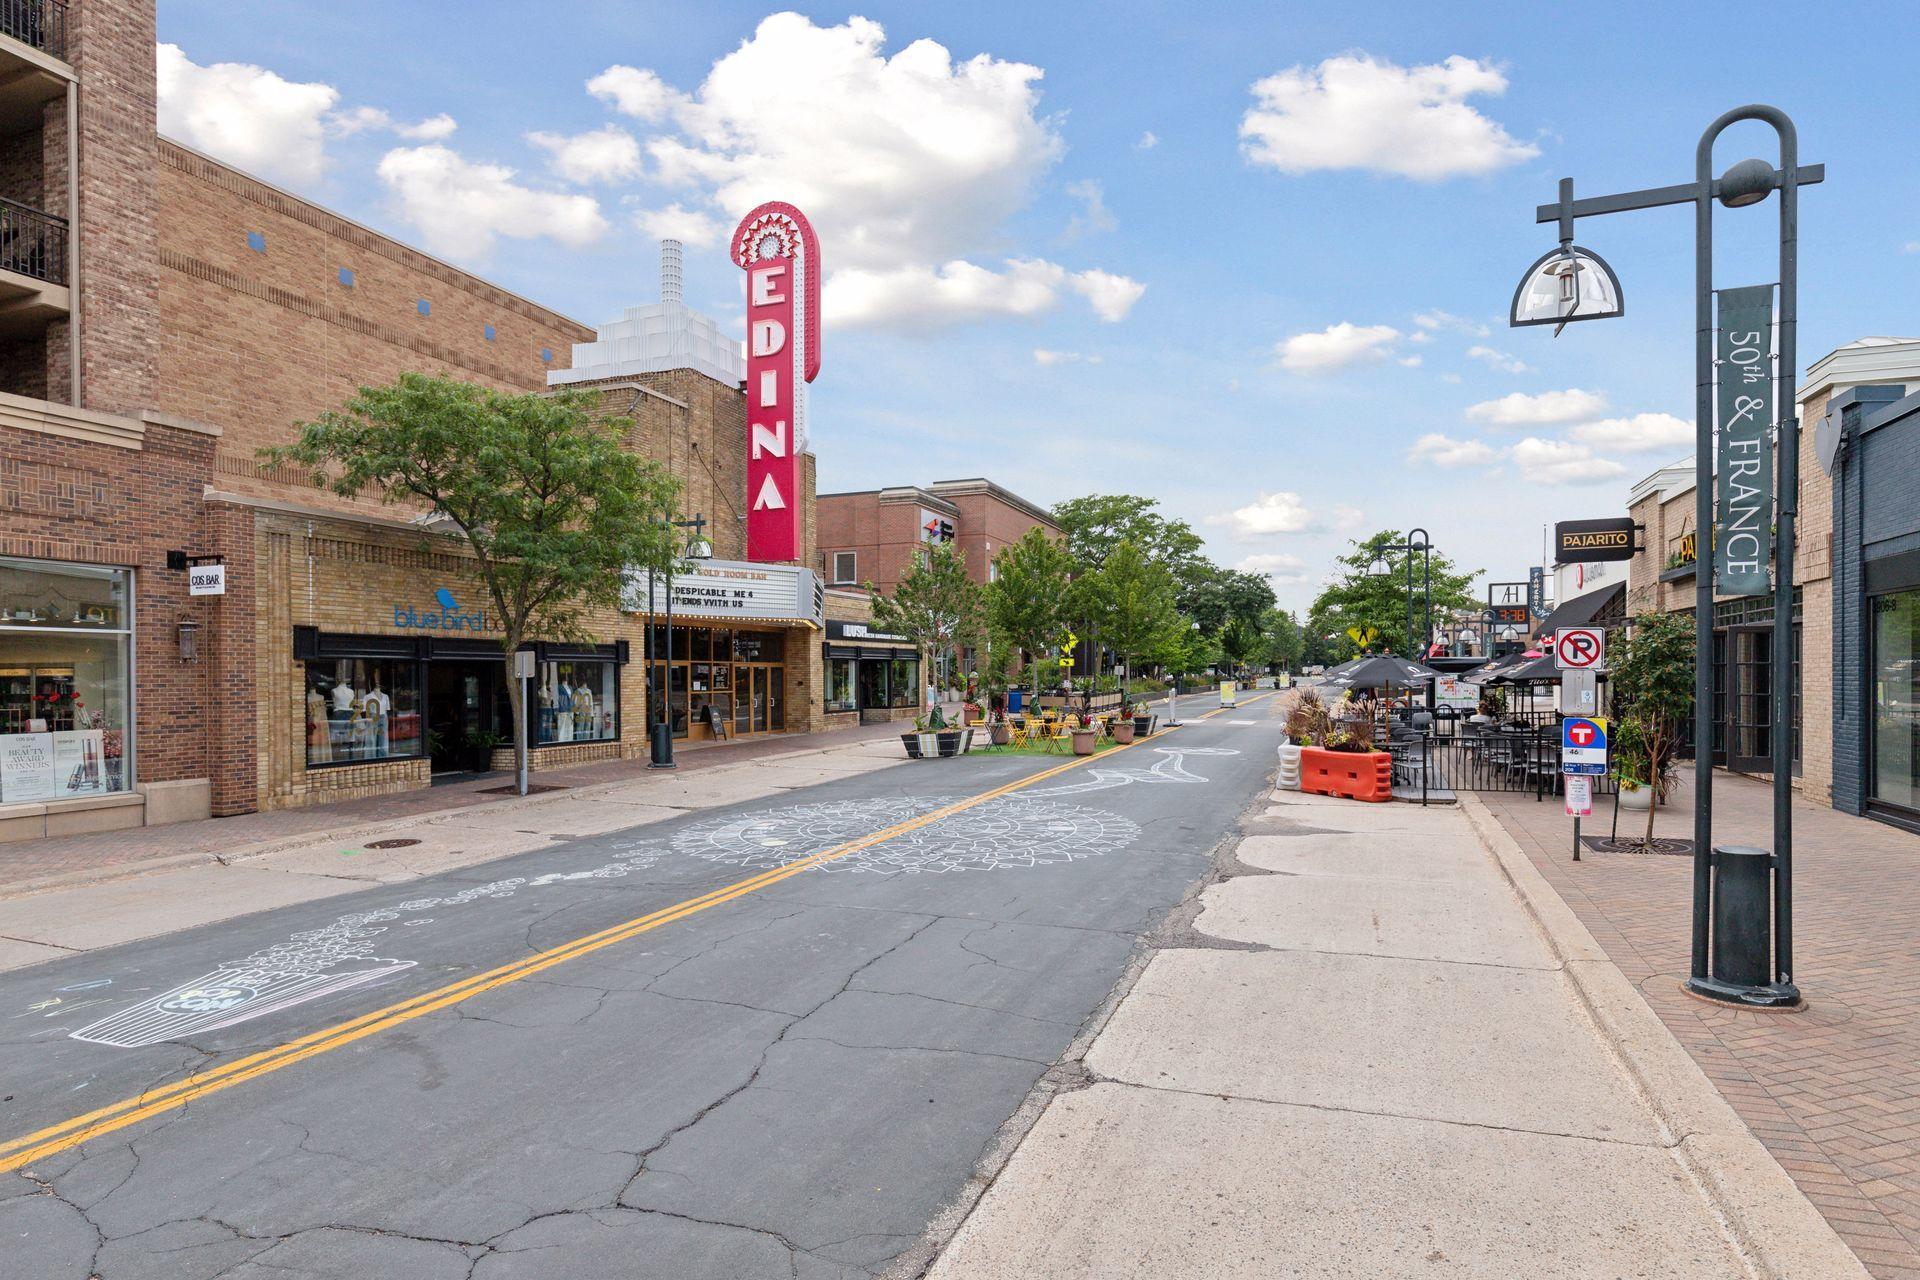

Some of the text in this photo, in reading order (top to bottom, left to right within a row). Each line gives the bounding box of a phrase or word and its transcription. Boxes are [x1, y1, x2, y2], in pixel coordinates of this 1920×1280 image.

[752, 265, 787, 511] EDINA
[1726, 331, 1765, 575] 50th & FRANCE
[1563, 533, 1628, 547] PAJARITO
[191, 574, 220, 585] COS BAR
[675, 587, 727, 597] DESPICABLE
[734, 590, 746, 598] ME
[843, 624, 868, 638] LUSH
[1528, 678, 1550, 686] Tito's
[1572, 728, 1592, 743] T
[8, 748, 45, 756] BEAUTY
[11, 755, 44, 763] AWARD
[6, 762, 50, 770] WINNERS
[179, 988, 242, 1000] POP
[163, 998, 245, 1011] CORN
